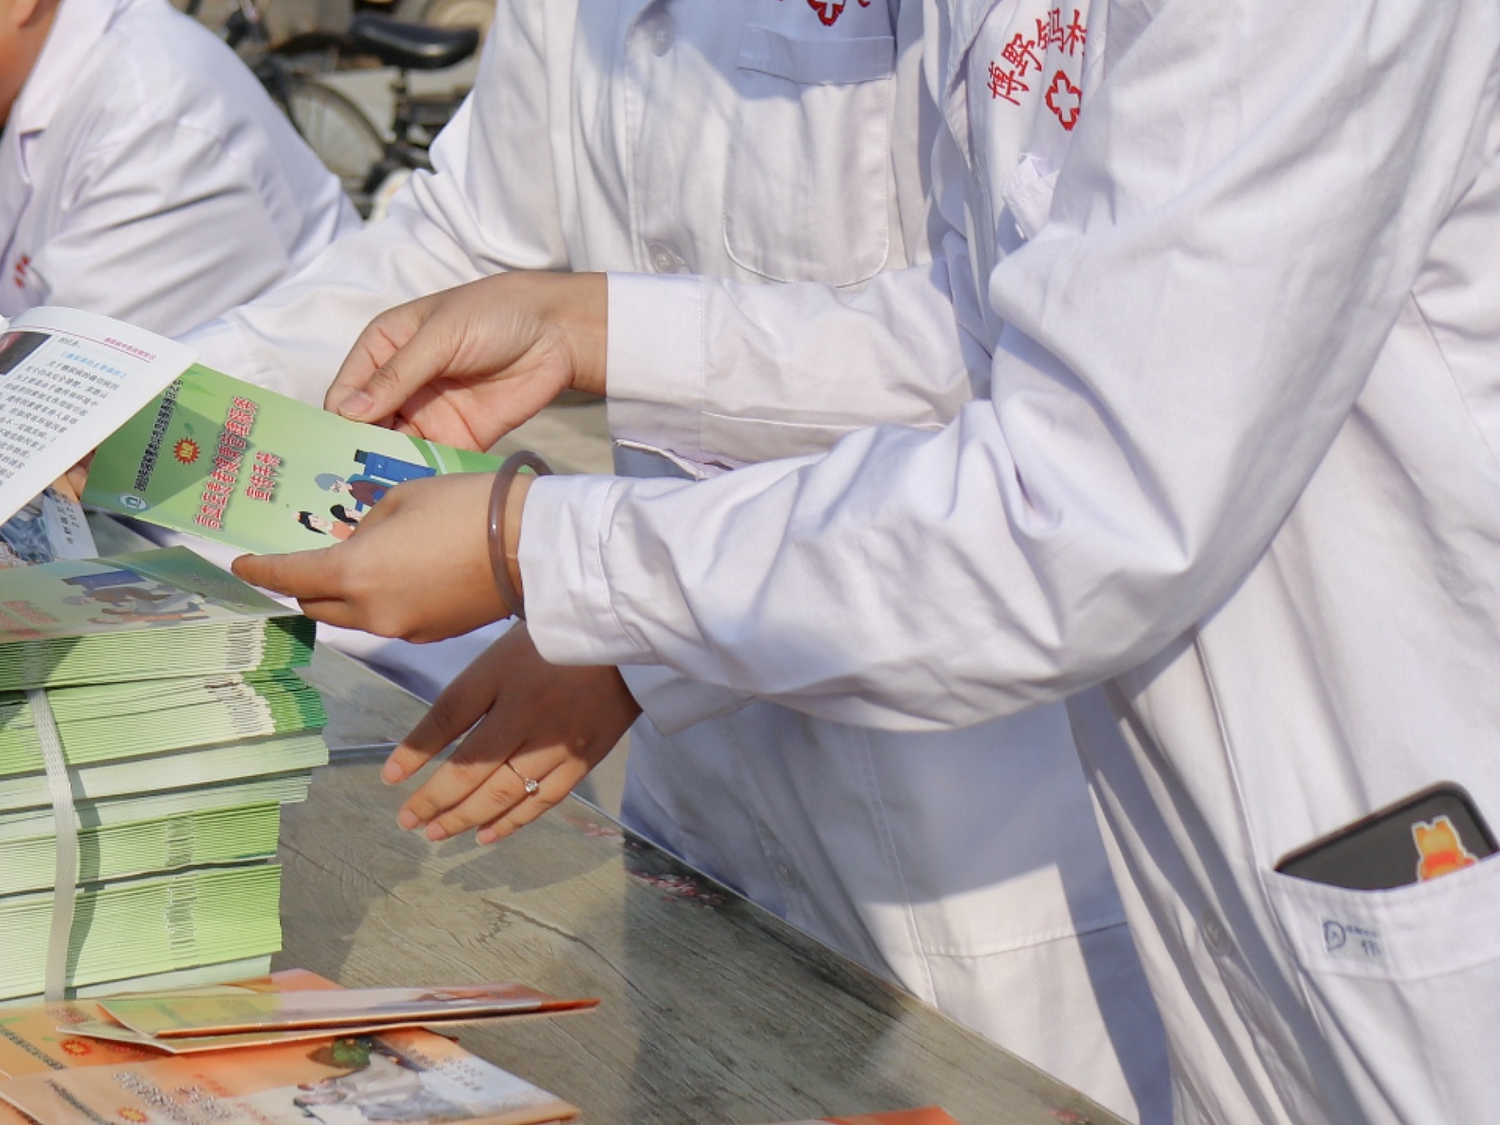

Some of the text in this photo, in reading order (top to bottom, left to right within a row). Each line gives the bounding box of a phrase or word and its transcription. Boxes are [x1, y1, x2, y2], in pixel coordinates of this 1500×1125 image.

[194, 395, 260, 531] 高血压患者健康管理服务
